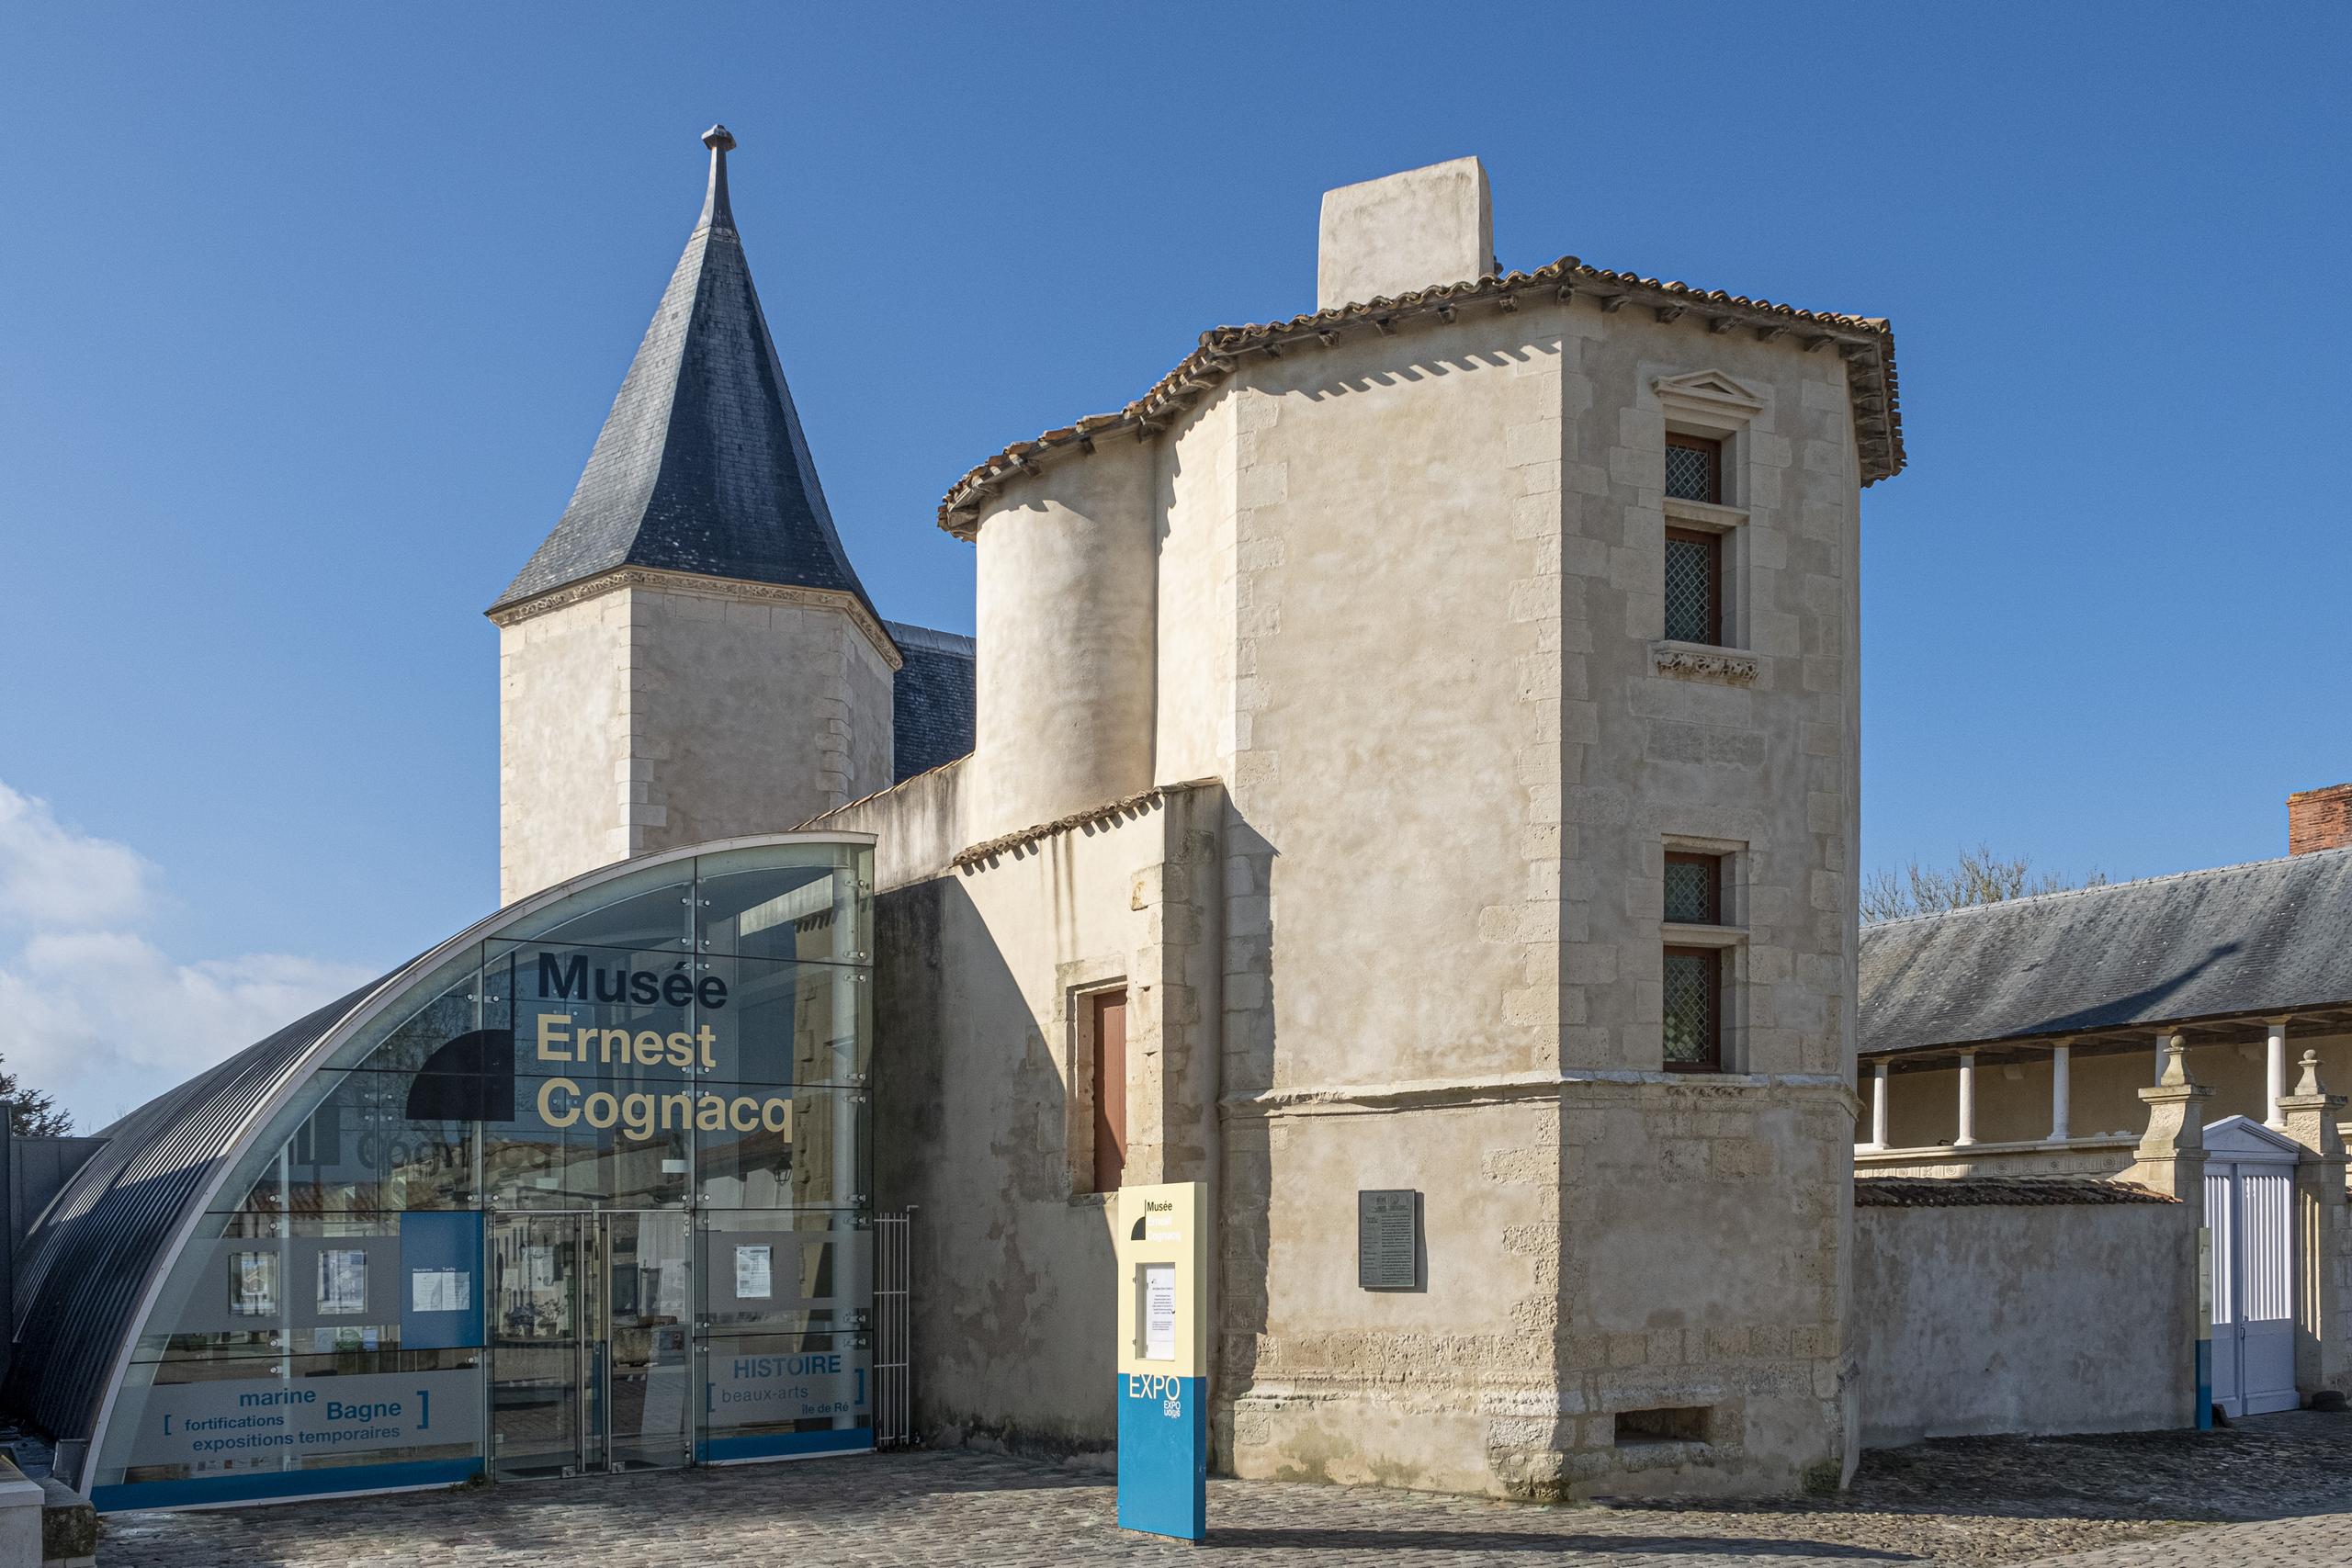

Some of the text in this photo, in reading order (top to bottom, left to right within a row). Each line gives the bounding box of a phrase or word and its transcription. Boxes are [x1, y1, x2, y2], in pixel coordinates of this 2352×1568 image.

[538, 952, 728, 1010] Musée
[537, 1013, 717, 1067] Ernest
[537, 1077, 793, 1144] Cognacq
[1147, 1200, 1173, 1213] Musée
[734, 1354, 842, 1379] HISTOIRE
[240, 1387, 317, 1407] marine
[722, 1385, 809, 1404] beaux-arts
[1129, 1373, 1181, 1401] EXPO
[327, 1401, 402, 1423] Bagne
[818, 1403, 831, 1414] de
[834, 1402, 849, 1413] Ré
[185, 1415, 285, 1432] fortifications
[193, 1426, 401, 1453] expositions temporaires
